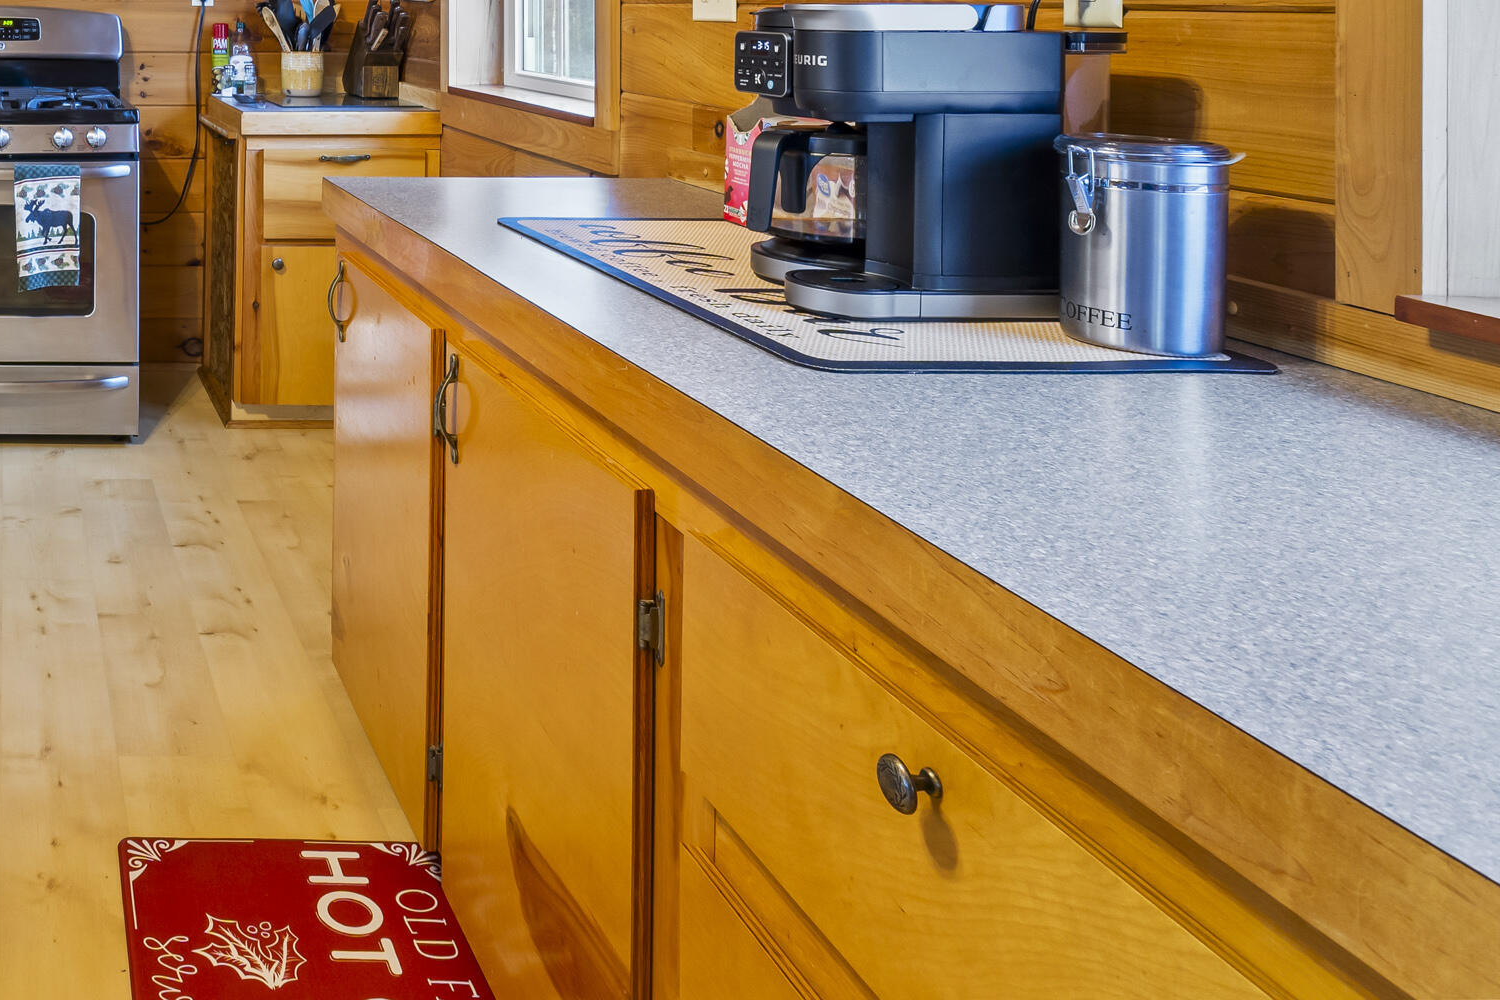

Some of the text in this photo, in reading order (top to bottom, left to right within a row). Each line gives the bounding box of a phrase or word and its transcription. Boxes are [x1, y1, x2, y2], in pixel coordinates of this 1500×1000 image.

[213, 38, 228, 49] PAM
[794, 53, 828, 67] EURIG
[299, 850, 403, 975] HOT
[395, 889, 460, 960] OLD
